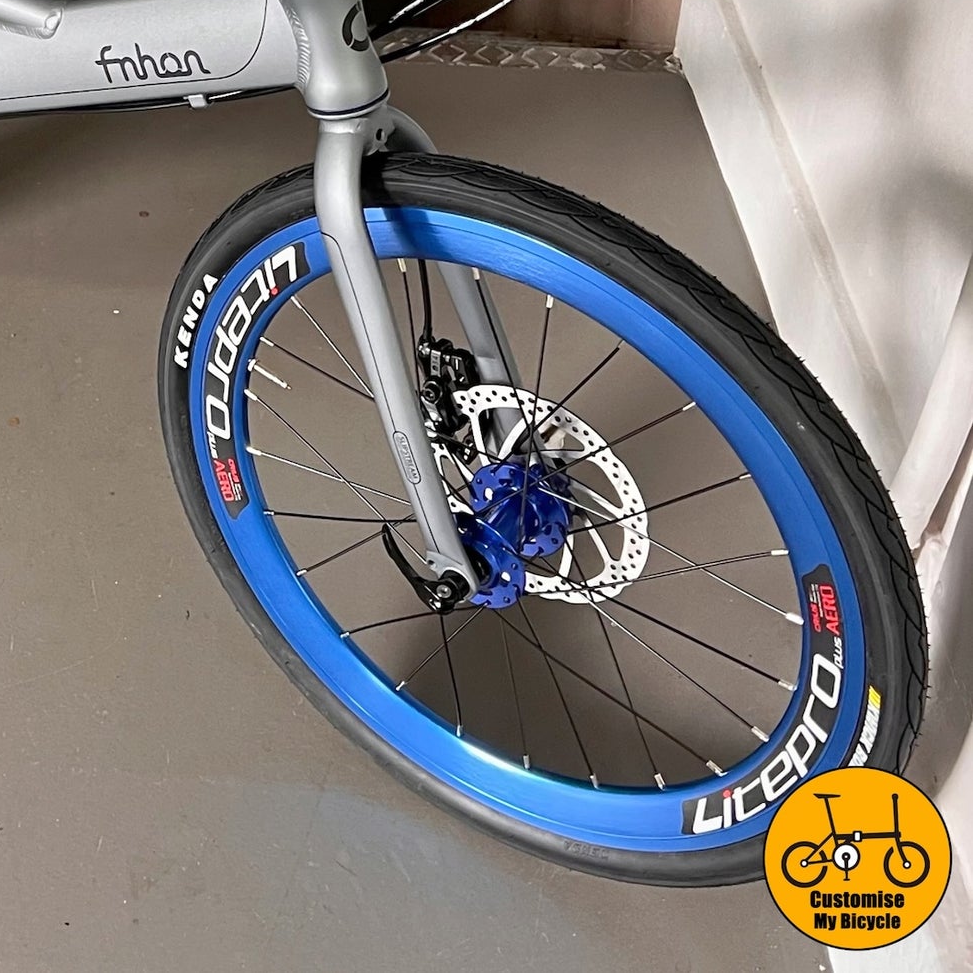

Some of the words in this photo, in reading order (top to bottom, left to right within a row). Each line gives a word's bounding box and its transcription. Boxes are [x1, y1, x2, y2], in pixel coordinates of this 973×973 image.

[94, 42, 212, 84] fnhan
[174, 273, 218, 369] KENDA
[214, 459, 235, 502] AERO
[819, 585, 841, 636] AERO
